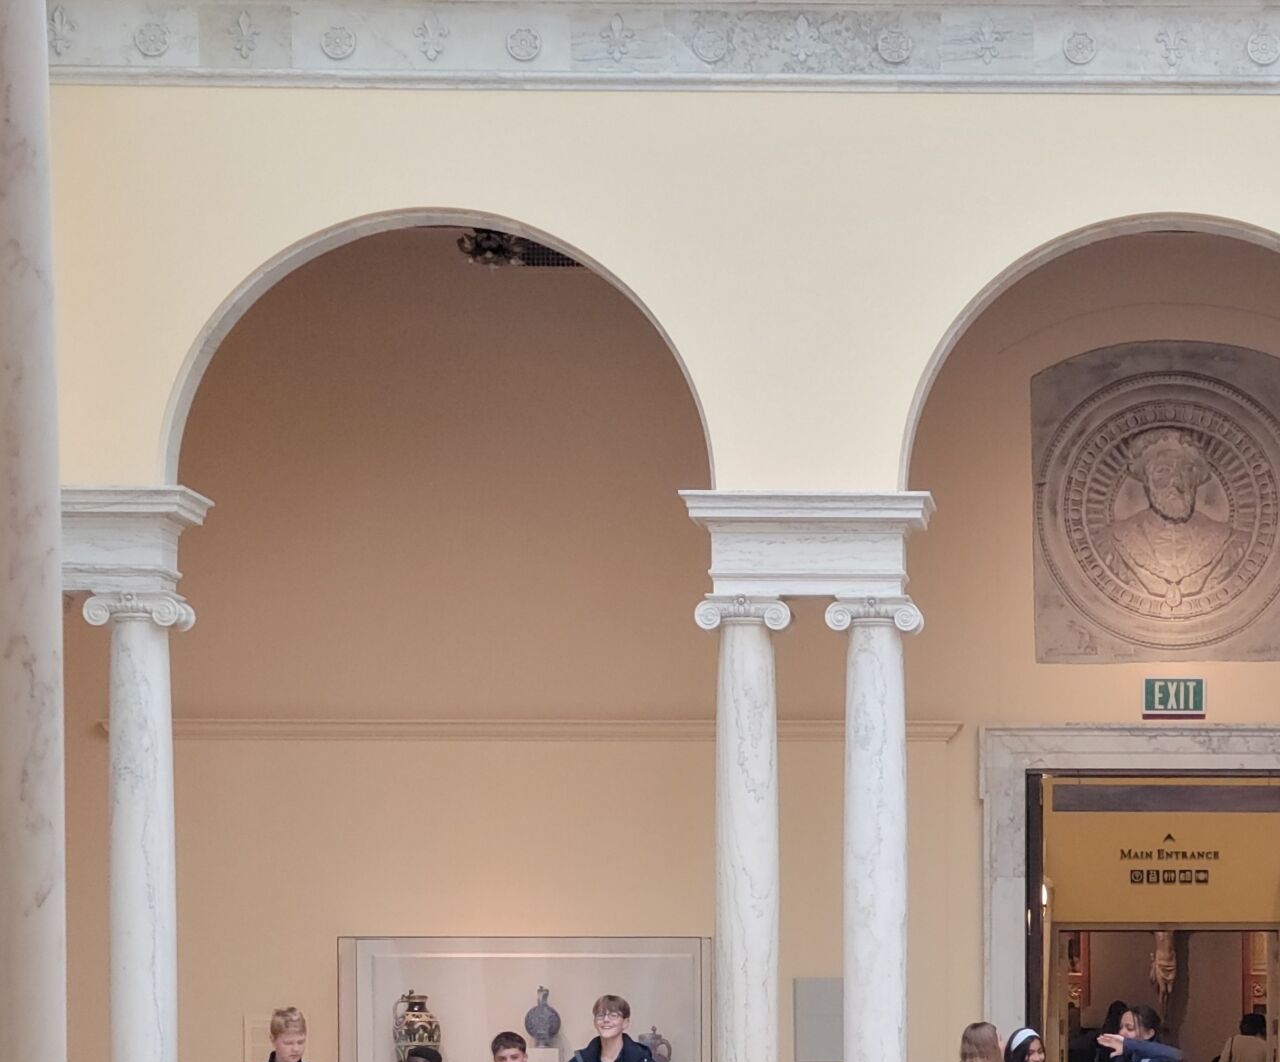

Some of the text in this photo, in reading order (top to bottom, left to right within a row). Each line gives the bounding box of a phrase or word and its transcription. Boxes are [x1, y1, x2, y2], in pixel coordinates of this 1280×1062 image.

[1154, 681, 1197, 710] EXIT
[1120, 848, 1220, 860] MAIN ENTRANCE
